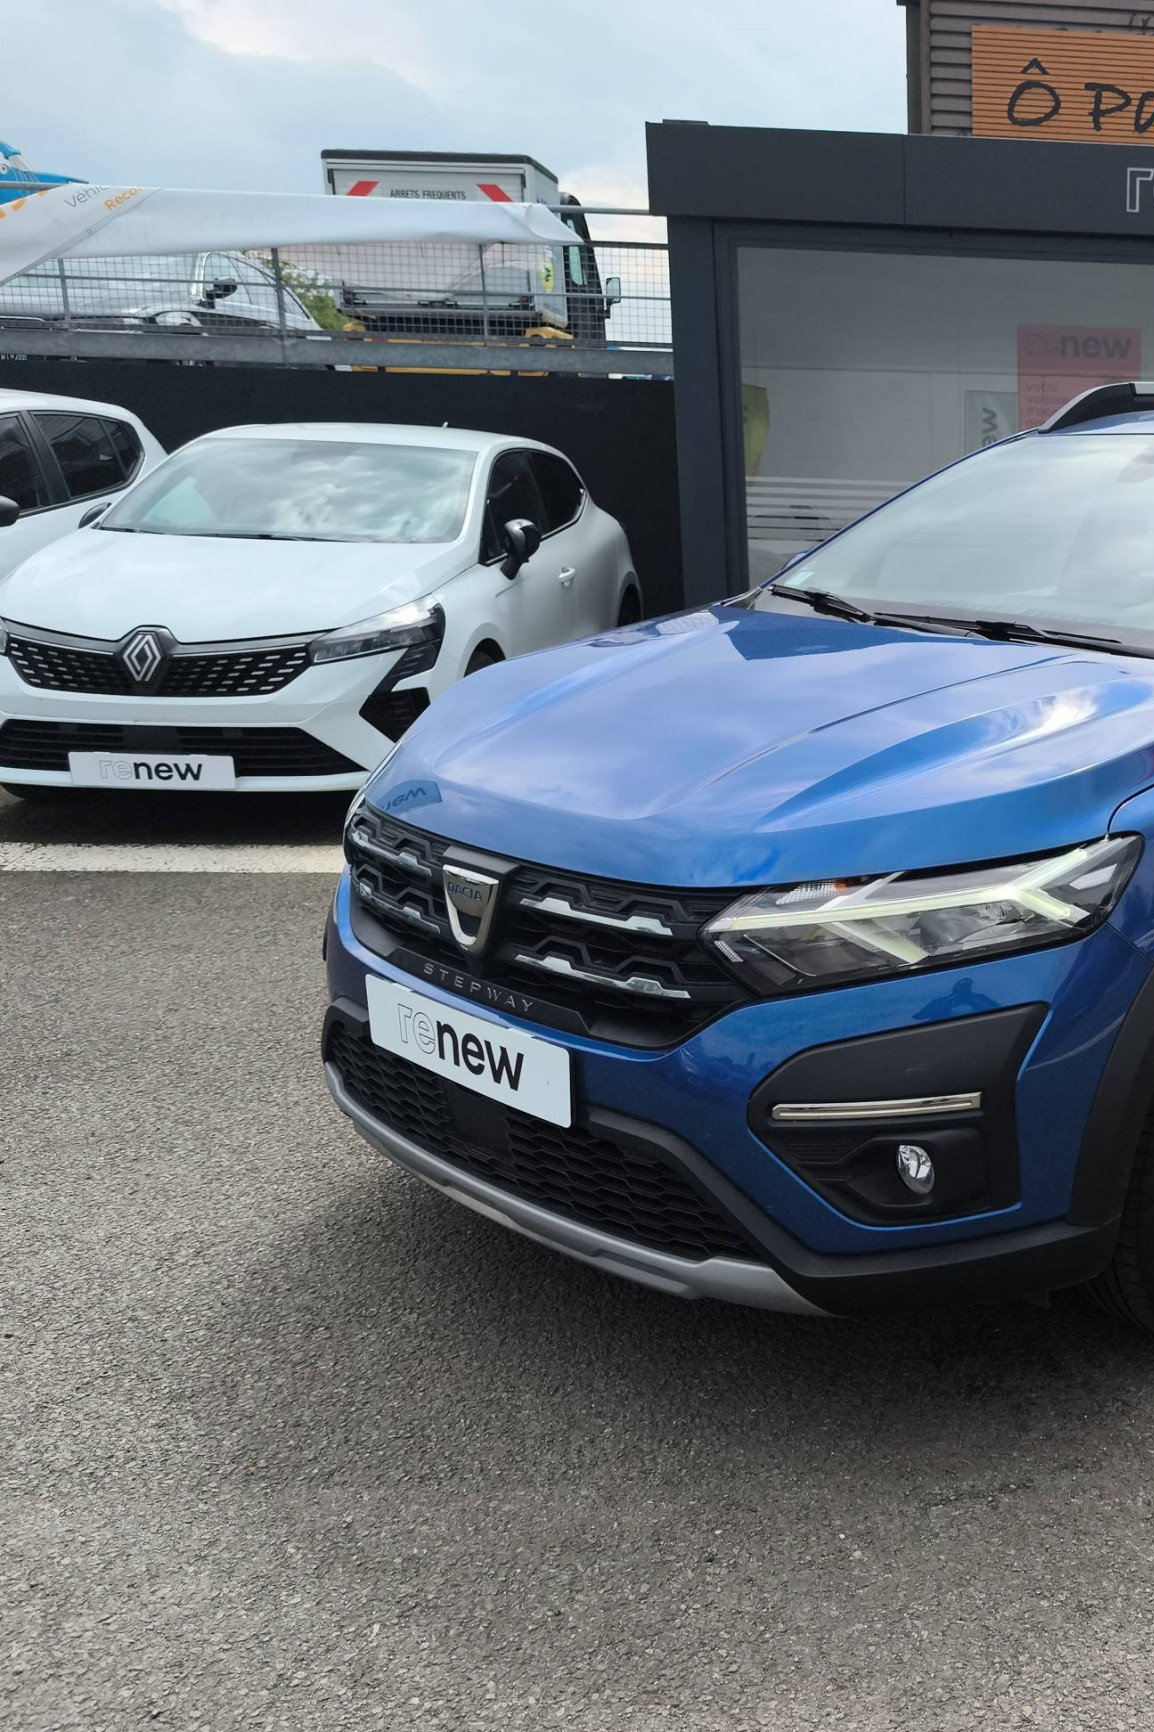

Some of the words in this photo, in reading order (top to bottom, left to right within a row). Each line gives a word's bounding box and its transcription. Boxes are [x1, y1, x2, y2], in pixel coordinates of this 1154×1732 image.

[1007, 57, 1062, 127] Ô
[104, 187, 142, 211] Reco
[390, 189, 420, 199] ARRETS
[1026, 333, 1132, 359] renew
[99, 759, 203, 781] renew
[448, 882, 484, 902] DACIA
[423, 962, 533, 1012] STEPWAY
[397, 1003, 525, 1092] renew
